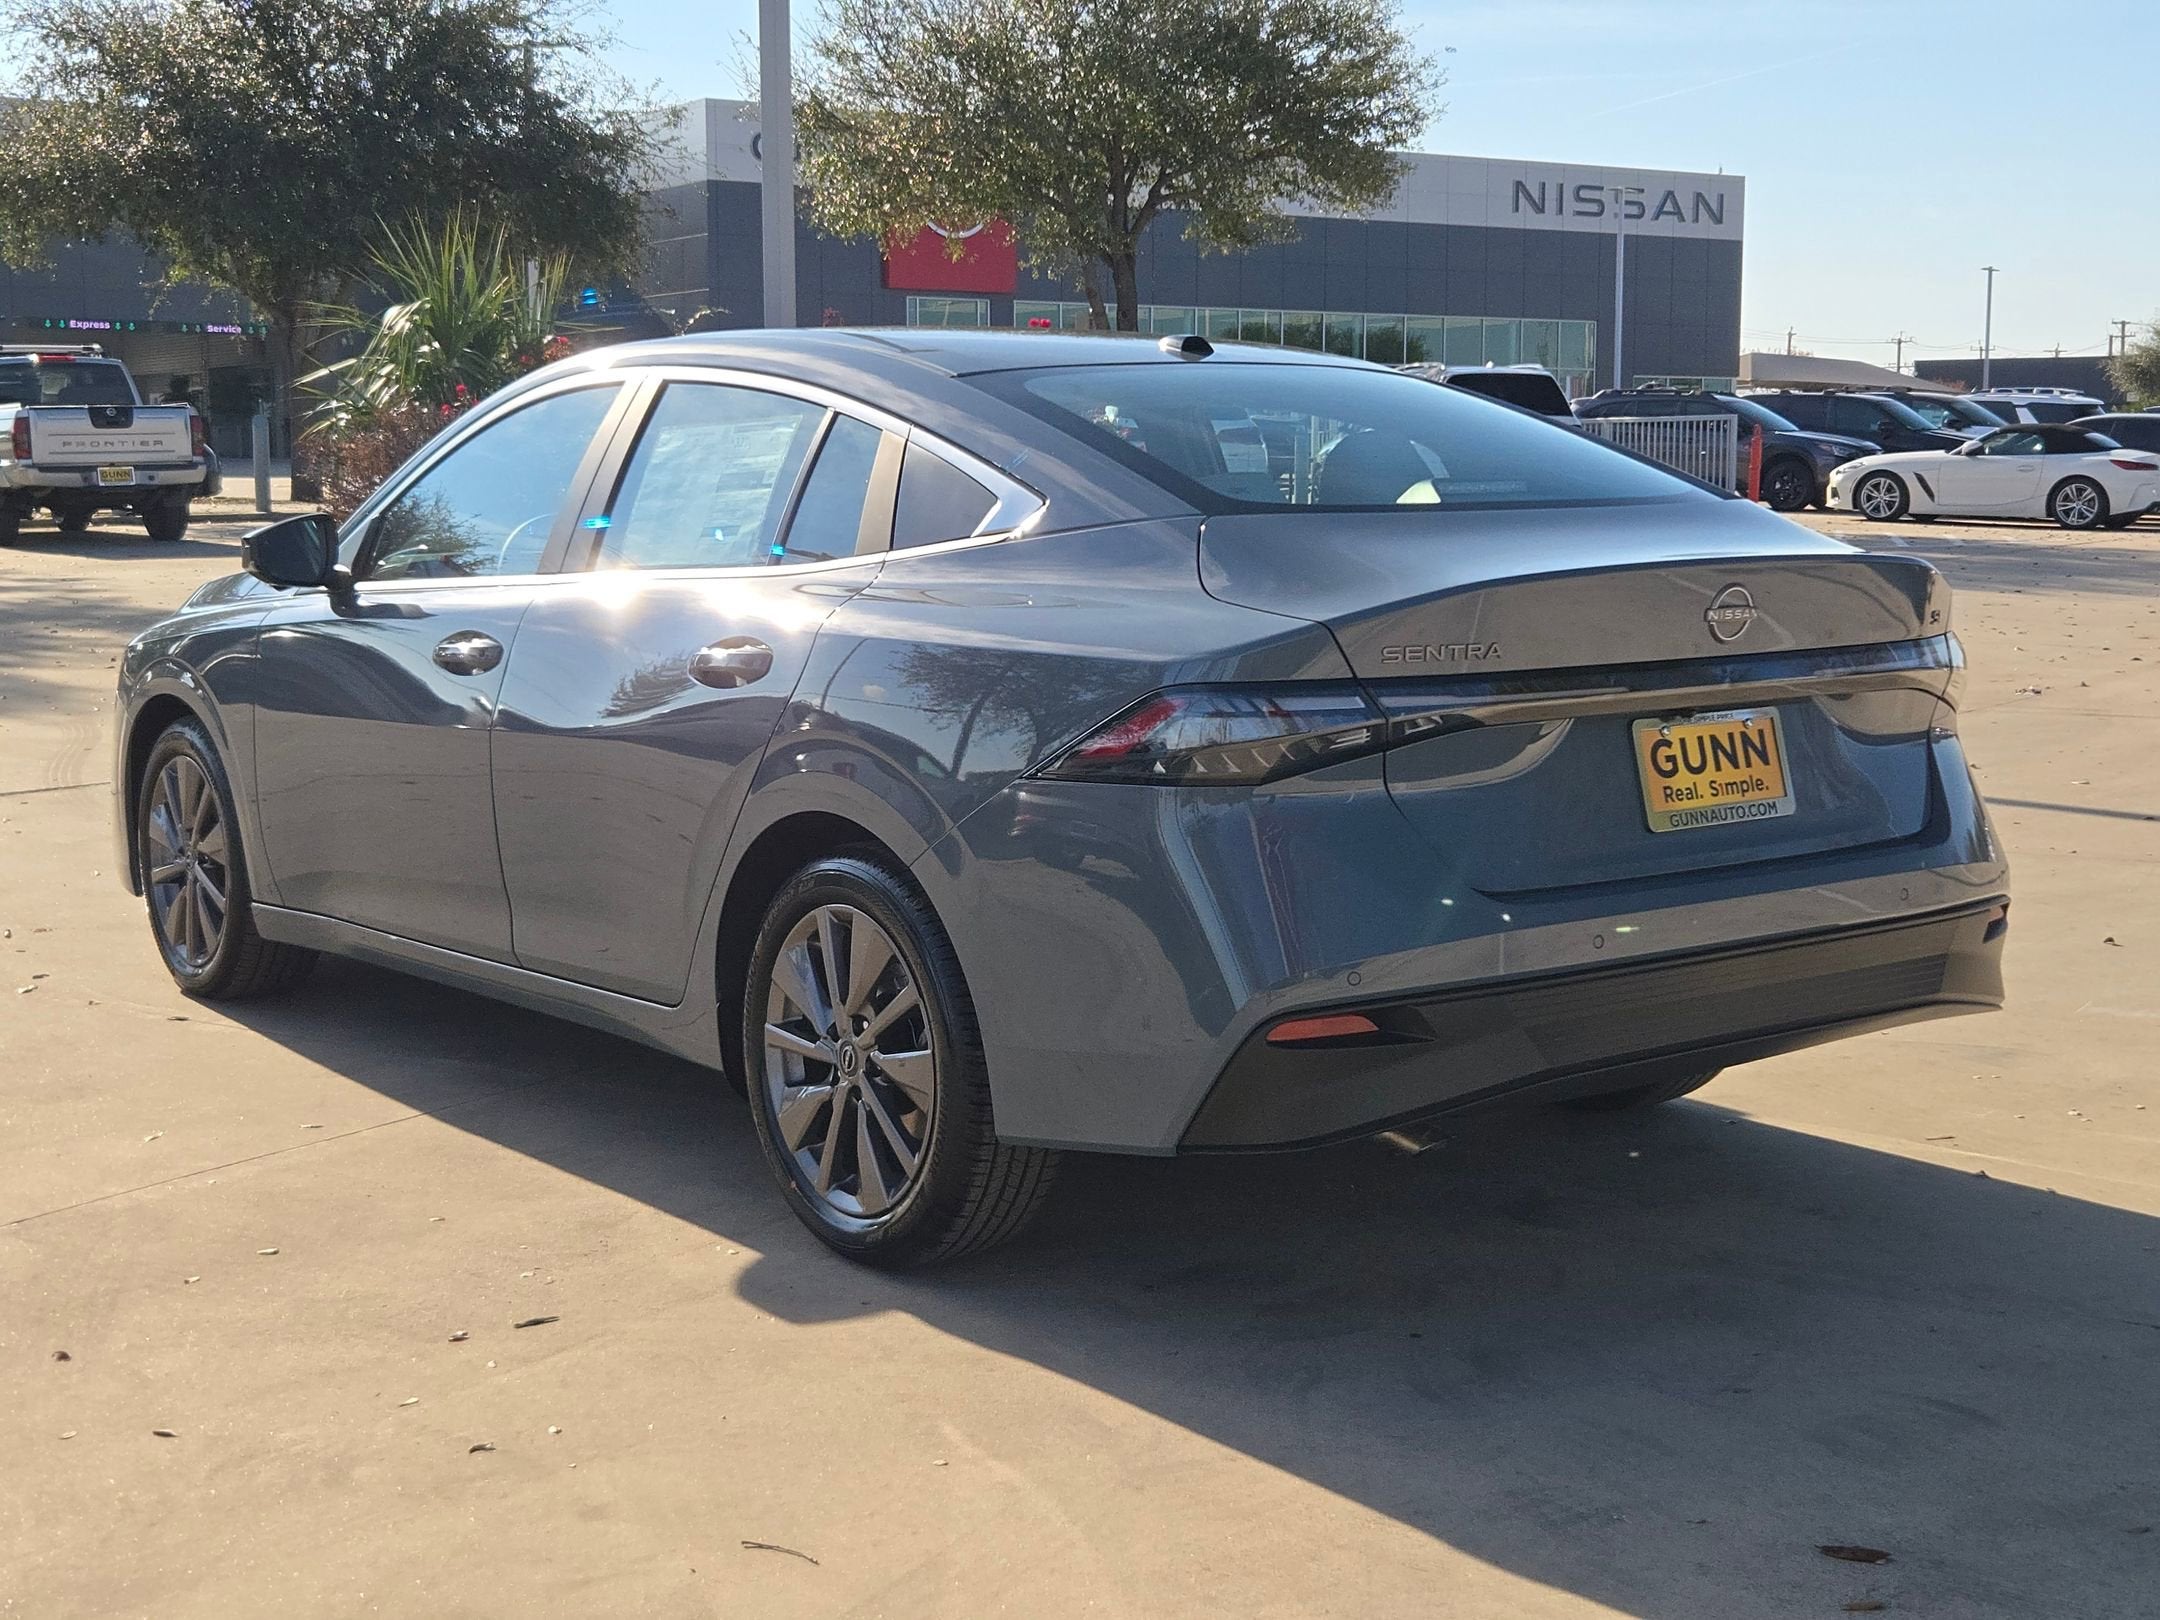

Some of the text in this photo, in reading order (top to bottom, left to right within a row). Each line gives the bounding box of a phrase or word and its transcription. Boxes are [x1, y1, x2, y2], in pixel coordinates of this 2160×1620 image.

[1512, 179, 1725, 225] NISSAN
[69, 319, 111, 331] Express
[207, 324, 242, 334] Service
[62, 439, 164, 448] FRONTIER
[101, 470, 131, 479] GUNN
[1707, 608, 1758, 620] NISSAN
[1381, 642, 1501, 663] SENTRA
[1650, 728, 1771, 779] GUNN
[1663, 782, 1704, 803] Real.
[1670, 800, 1779, 827] GUNNAUTO.COM
